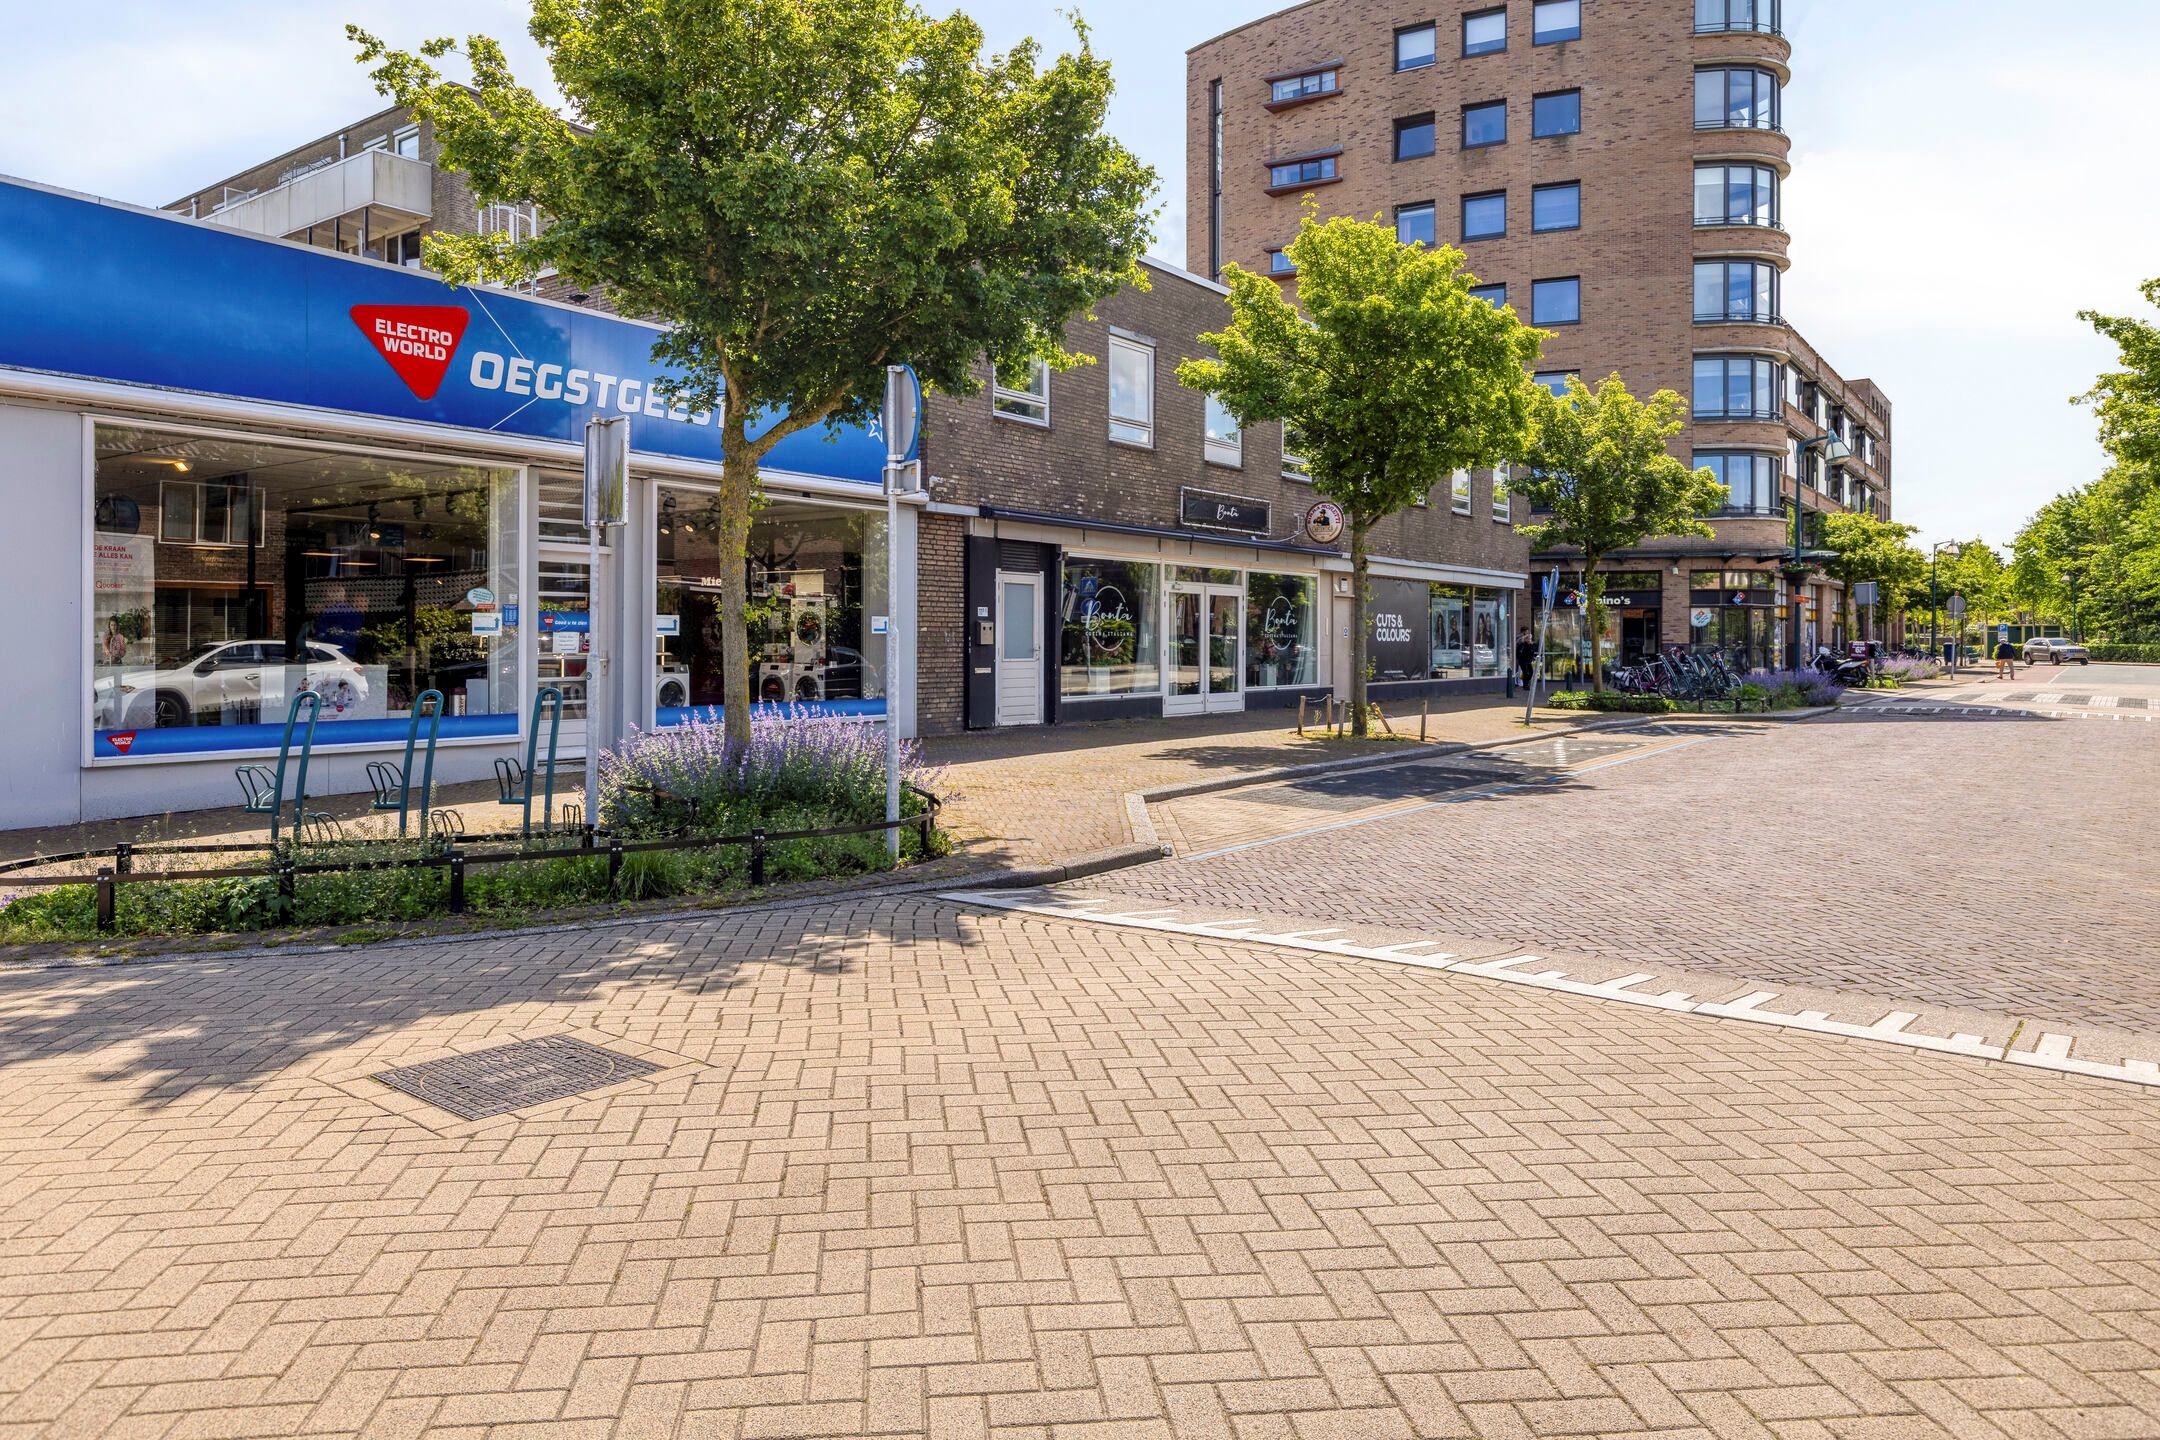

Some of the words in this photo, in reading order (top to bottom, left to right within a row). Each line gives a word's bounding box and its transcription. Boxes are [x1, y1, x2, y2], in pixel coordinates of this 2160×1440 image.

[375, 318, 453, 346] ELECTRO
[383, 336, 447, 361] WORLD
[701, 576, 722, 587] Mie
[1376, 613, 1397, 628] CUTS
[1397, 614, 1403, 628] &
